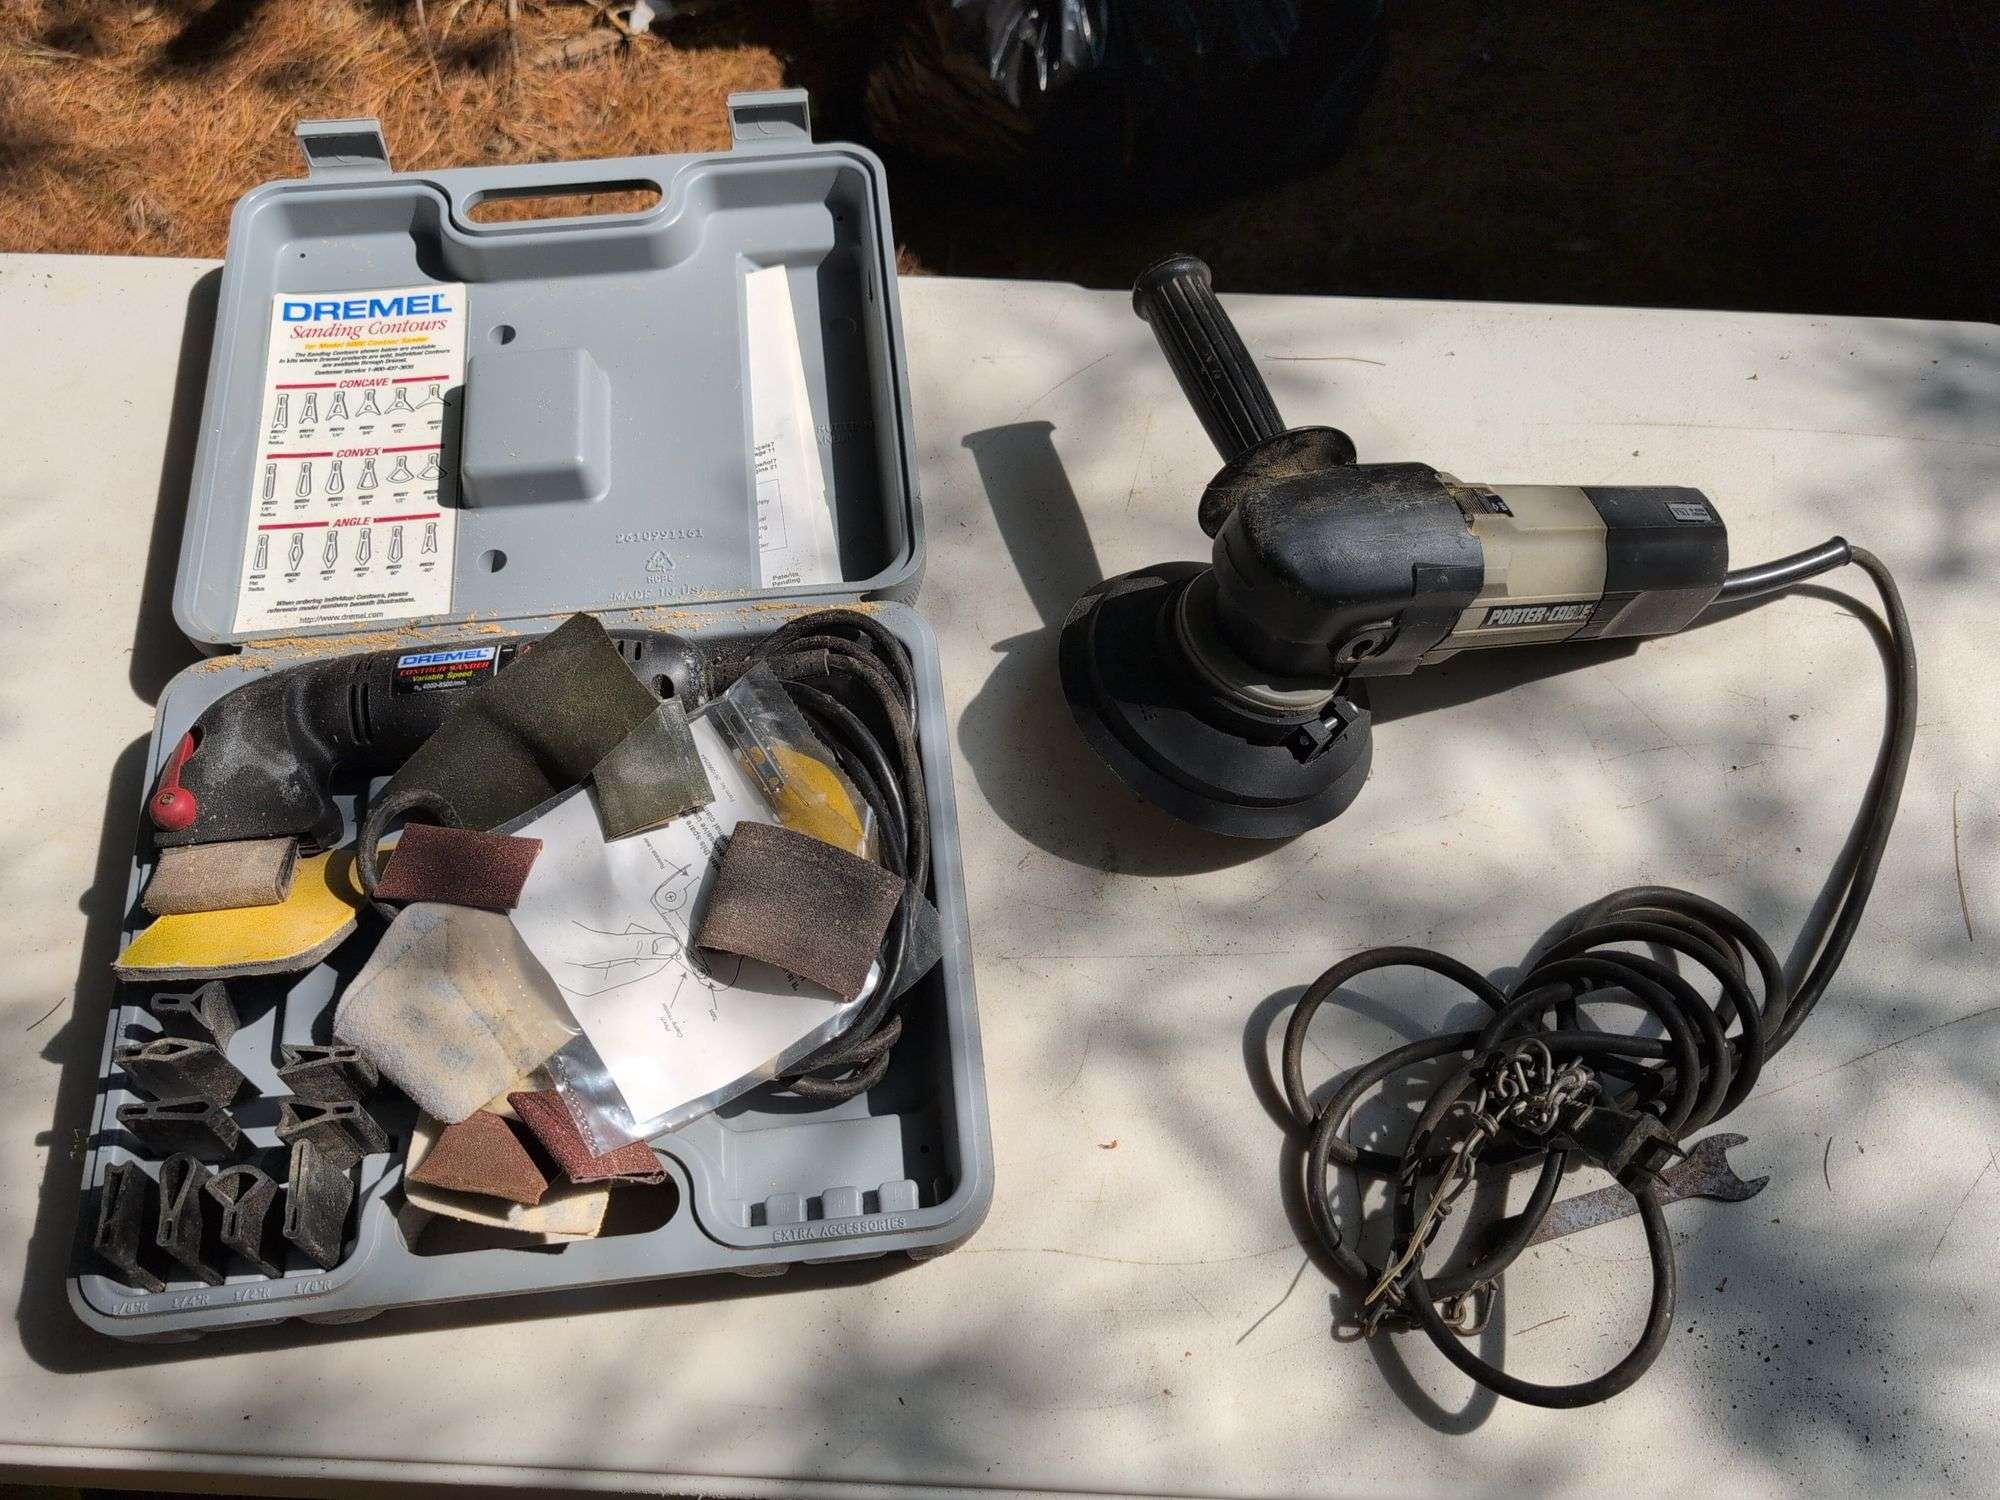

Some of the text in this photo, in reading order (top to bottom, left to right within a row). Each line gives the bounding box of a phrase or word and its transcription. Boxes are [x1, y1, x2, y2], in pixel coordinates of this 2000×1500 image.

[282, 294, 452, 322] DREMEL
[290, 319, 448, 340] Sanding Contours
[339, 378, 389, 389] CONCAVE
[336, 448, 381, 458] CONVEX
[333, 517, 371, 527] ANGLE
[296, 598, 323, 606] ordering
[388, 591, 409, 599] please
[611, 589, 652, 601] MADE
[401, 650, 488, 665] DREMEL
[400, 661, 491, 677] CONTOUR SANDER
[412, 670, 474, 682] Variable Speed
[685, 819, 701, 840] spare
[773, 1217, 907, 1242] EXTRA ACCESSORIES
